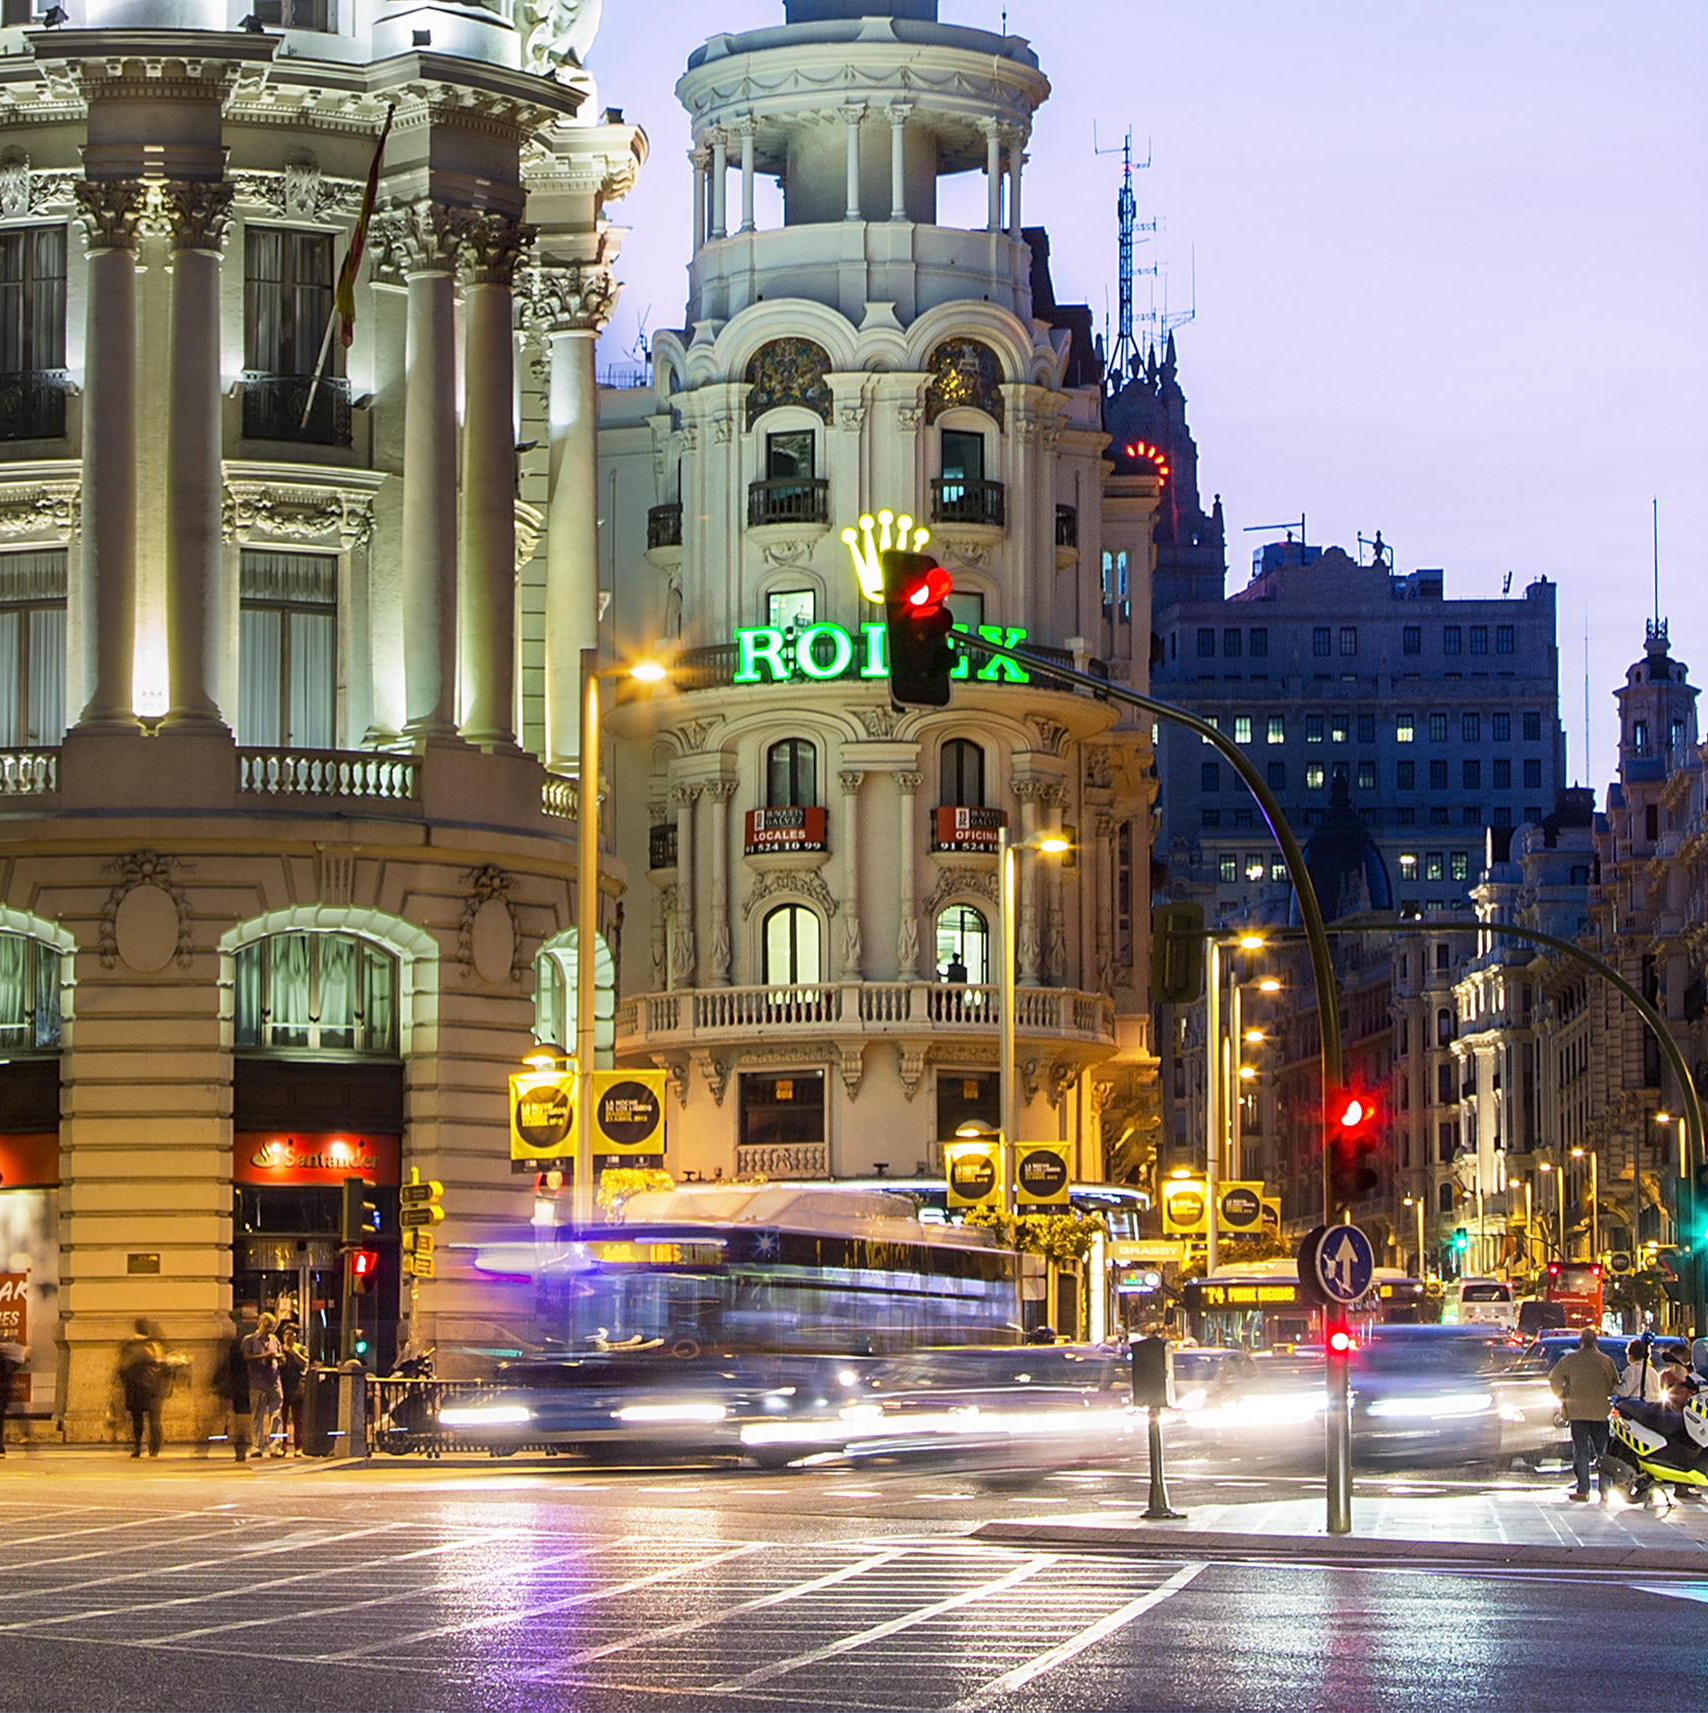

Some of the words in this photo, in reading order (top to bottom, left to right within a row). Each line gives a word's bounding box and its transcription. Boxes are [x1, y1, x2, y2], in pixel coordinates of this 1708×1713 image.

[753, 829, 807, 842] LOCALES
[745, 845, 755, 853] 91
[757, 843, 779, 853] 524
[784, 842, 801, 851] 10
[804, 842, 822, 850] 99
[940, 842, 956, 850] 91
[961, 842, 985, 851] 524
[283, 1147, 379, 1171] Santander
[1119, 1246, 1178, 1255] GRASSY
[1207, 1287, 1225, 1305] 74
